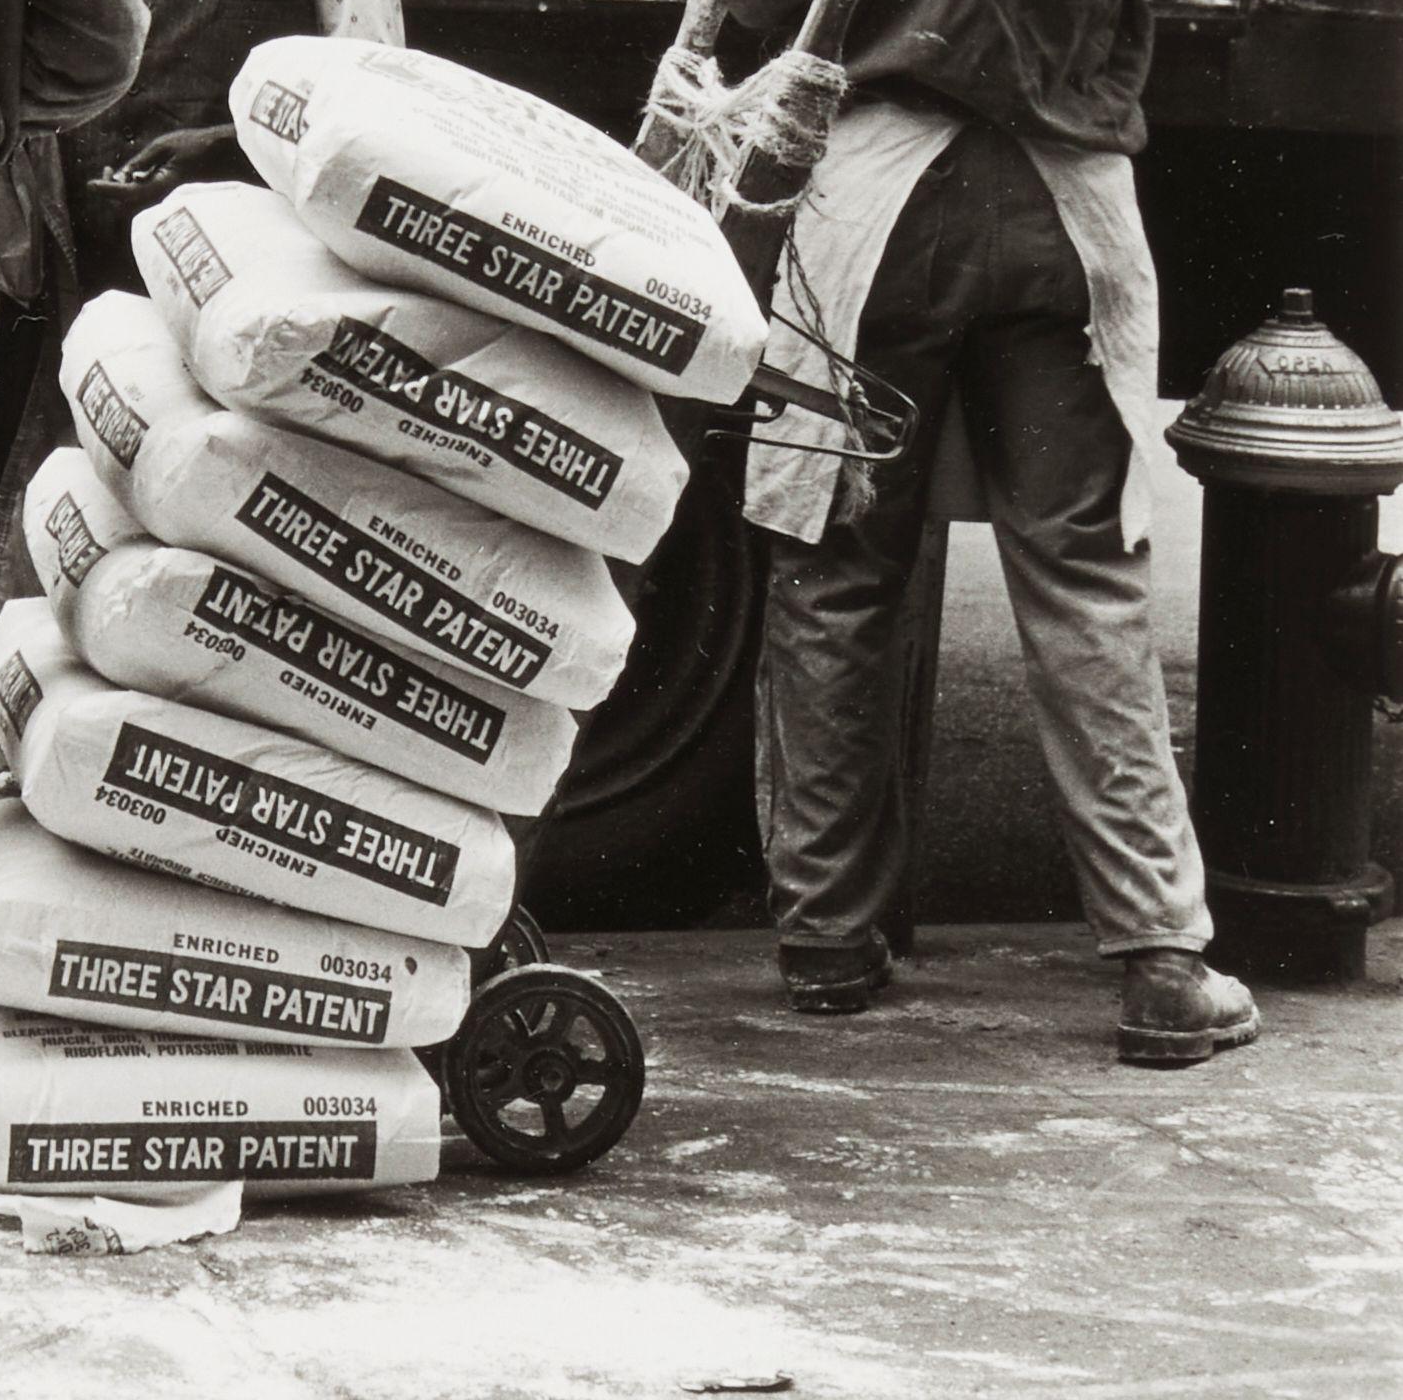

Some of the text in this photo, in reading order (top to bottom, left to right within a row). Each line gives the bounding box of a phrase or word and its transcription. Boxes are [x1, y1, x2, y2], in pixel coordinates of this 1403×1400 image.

[378, 195, 685, 358] THREE STAR PATENT
[500, 211, 714, 323] ENRICHED 003034
[299, 367, 493, 469] ENRICHED 003034
[332, 331, 609, 498] THREE STAR PATENT
[250, 485, 539, 681] THREE STAR PATENT
[368, 514, 559, 641] ENRICHED 003034
[279, 669, 378, 731] ENRICHED
[317, 631, 394, 698] STAR
[396, 677, 493, 751] THREE
[96, 784, 319, 879] ENRICHED 003034
[125, 744, 436, 888] THREE STAR PATENT
[59, 954, 384, 1036] THREE STAR PATENT
[173, 933, 393, 983] ENRICHED 003034
[64, 1046, 151, 1059] RIBOFLAVIN,
[157, 1042, 239, 1057] POTASSIUM
[142, 1097, 378, 1118] ENRICHED 003034
[27, 1135, 358, 1172] THREE STAR PATENT
